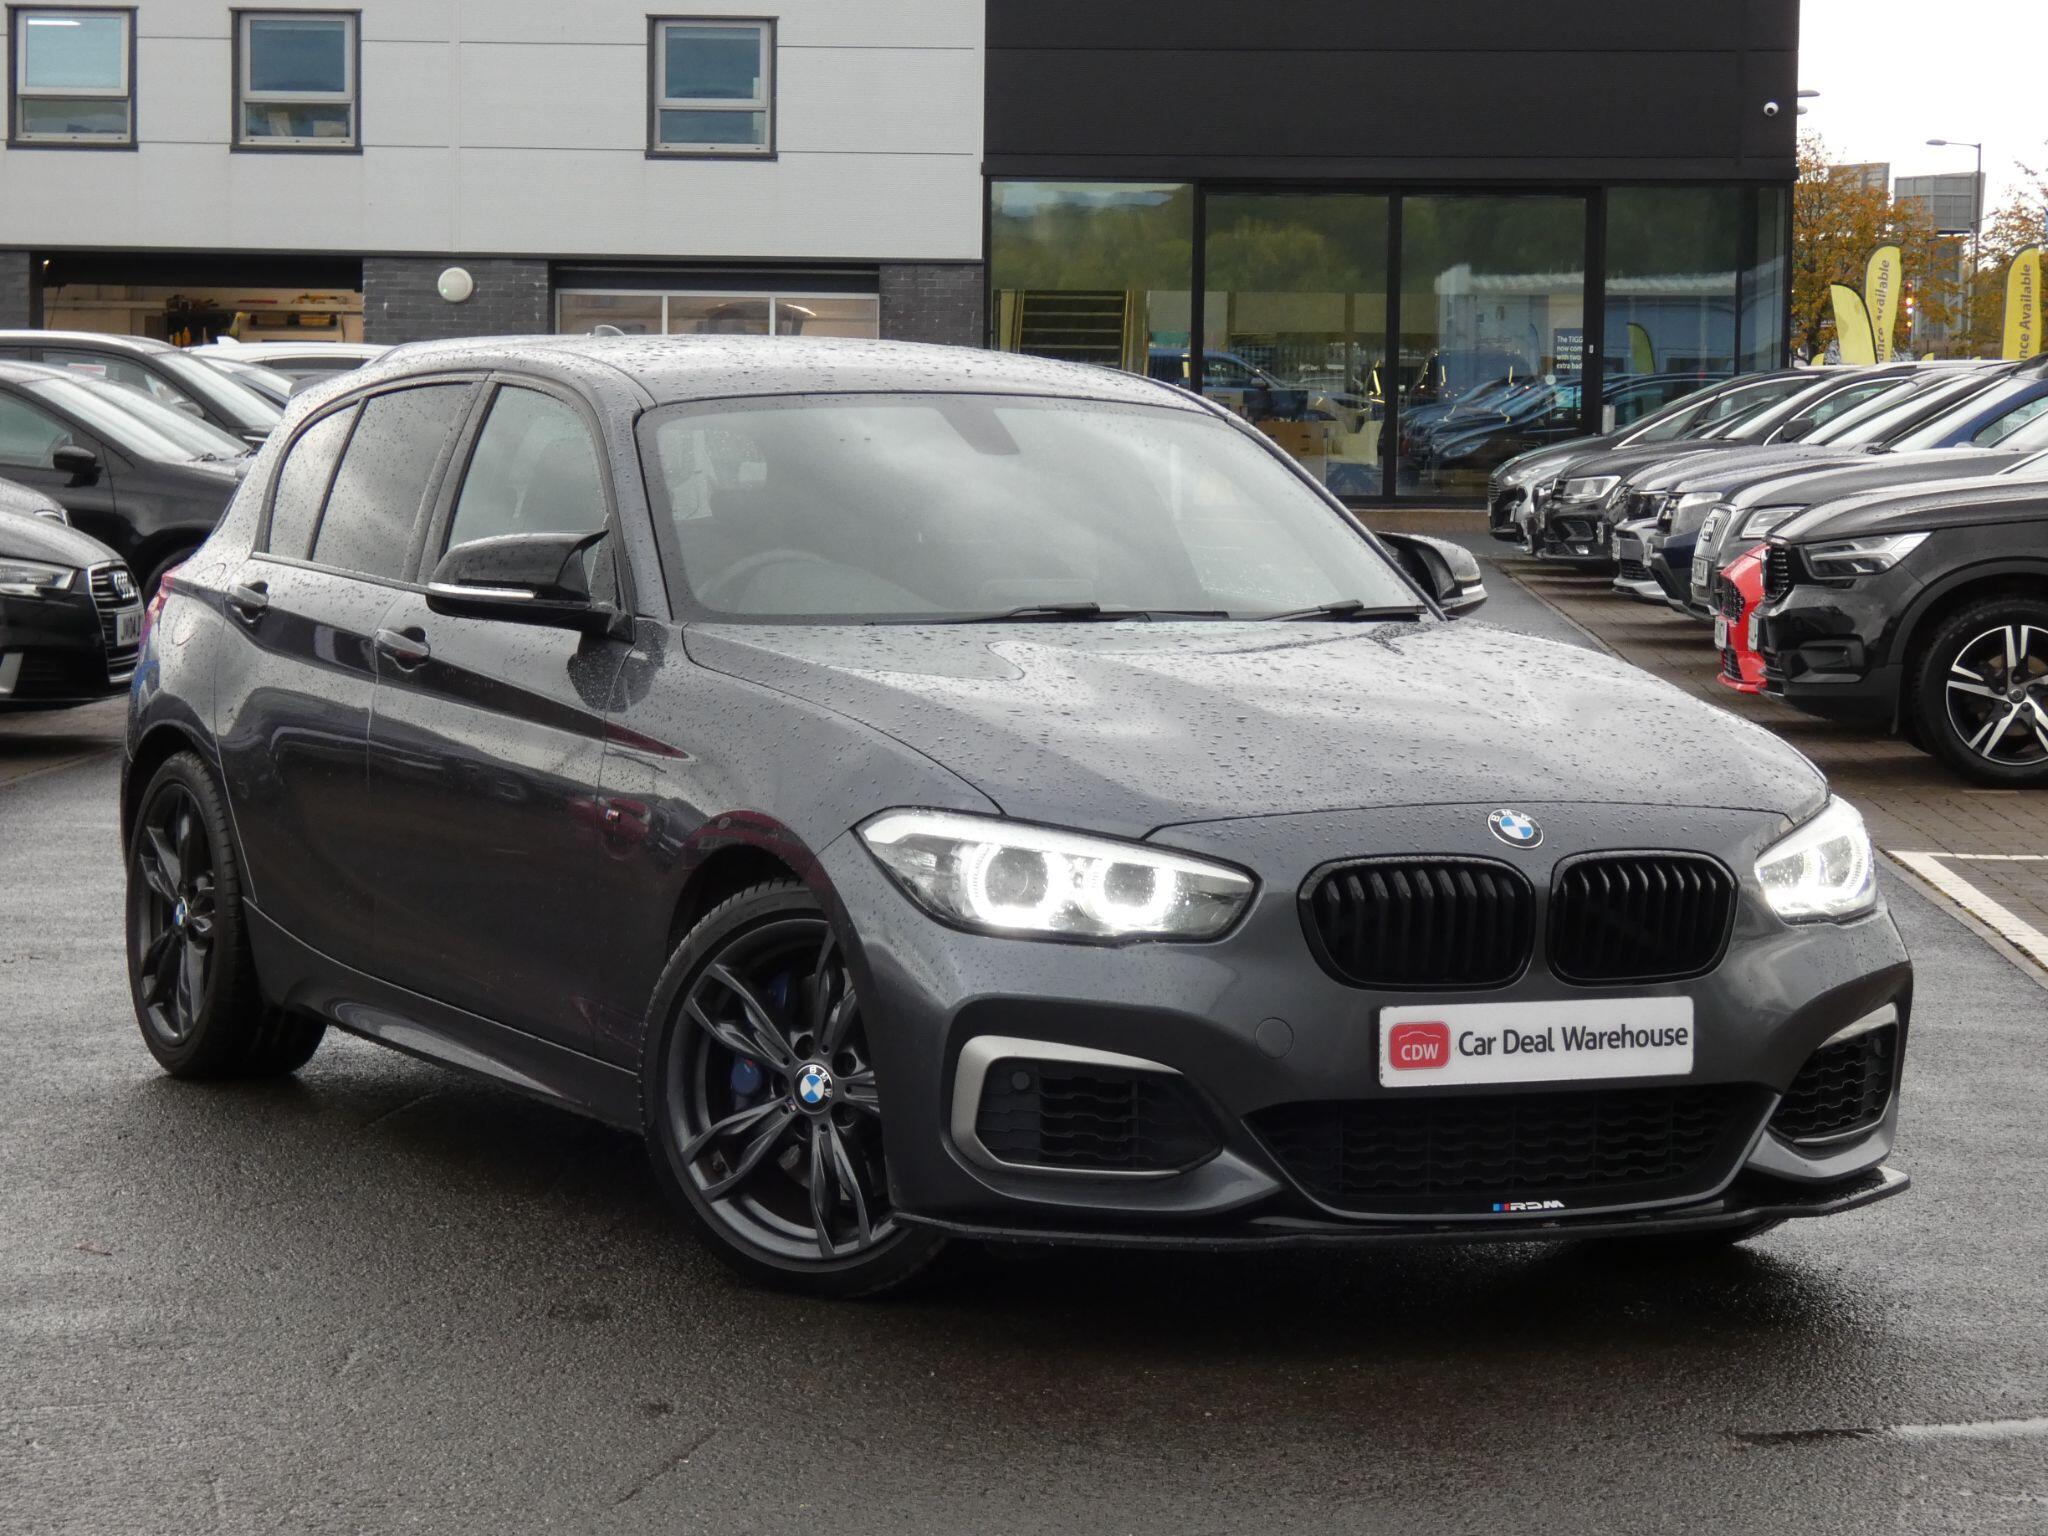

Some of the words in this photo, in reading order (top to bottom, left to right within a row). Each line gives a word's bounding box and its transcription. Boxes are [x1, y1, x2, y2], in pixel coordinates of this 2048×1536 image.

[2019, 263, 2032, 330] Available
[1557, 335, 1567, 343] The
[1458, 1031, 1496, 1057] Car
[1503, 1027, 1555, 1055] Deal
[1562, 1024, 1689, 1052] Warehouse
[1401, 1043, 1439, 1061] CDW
[1510, 1200, 1566, 1211] RDM
